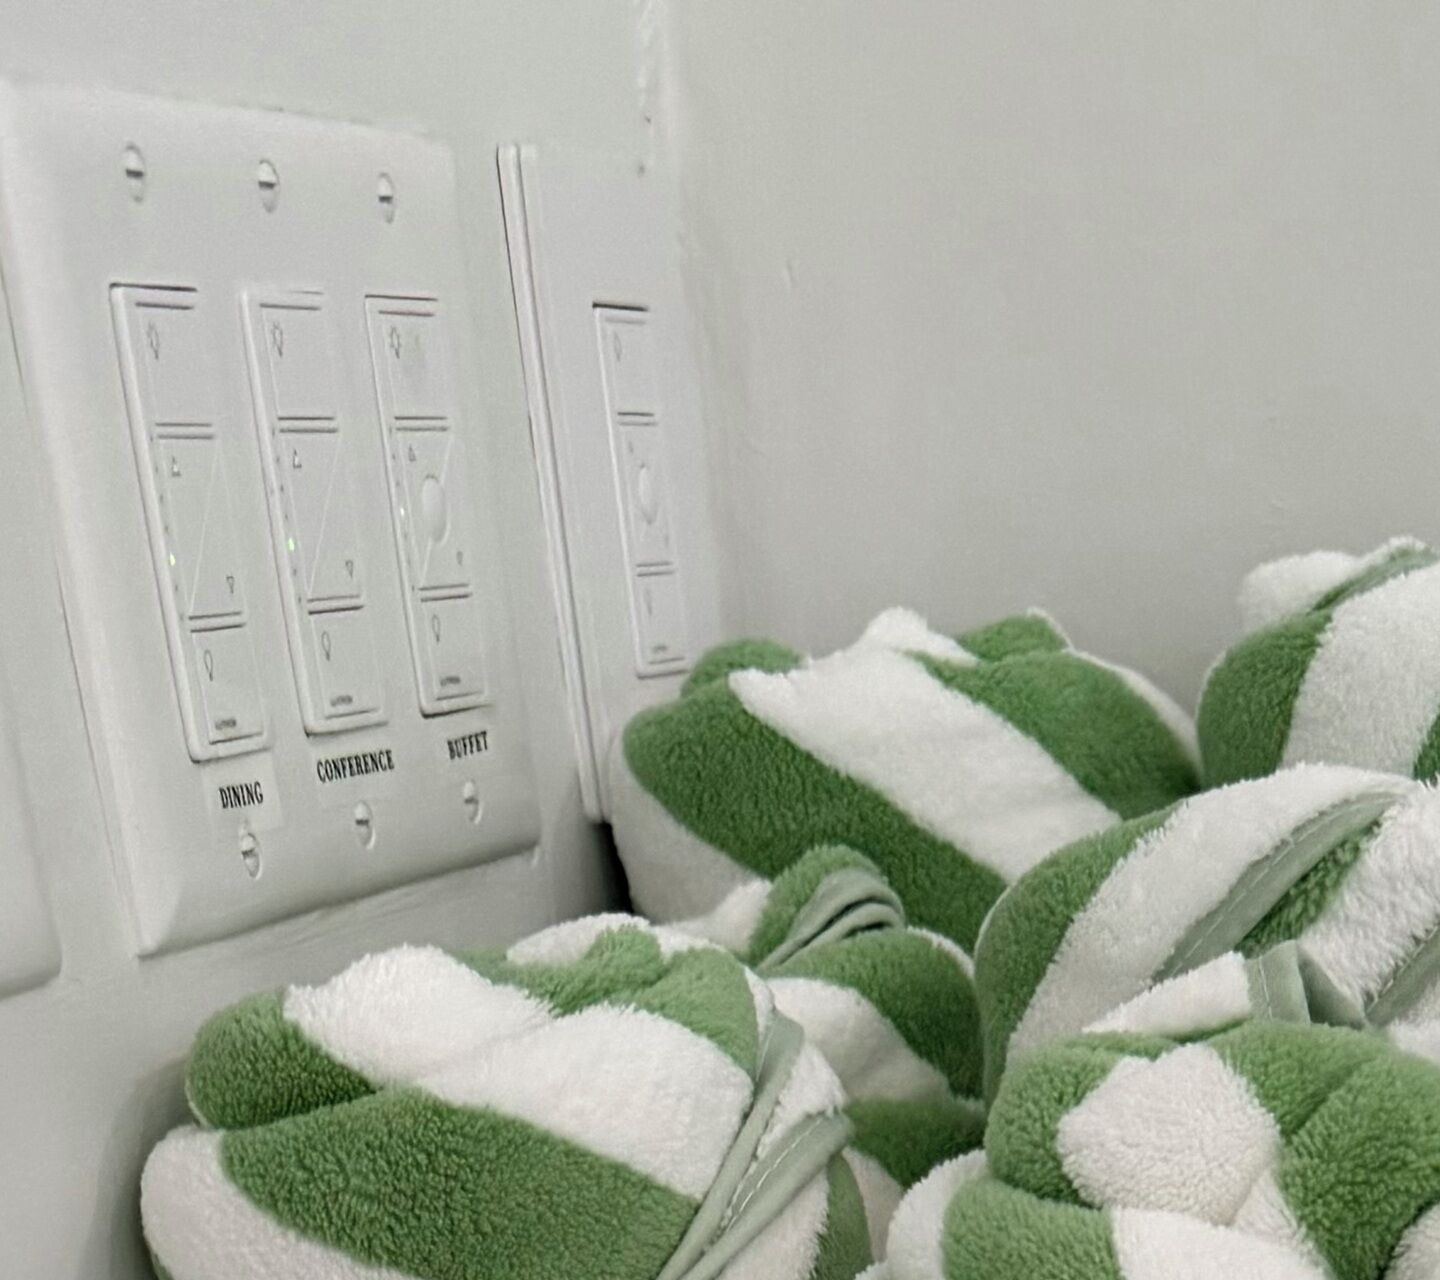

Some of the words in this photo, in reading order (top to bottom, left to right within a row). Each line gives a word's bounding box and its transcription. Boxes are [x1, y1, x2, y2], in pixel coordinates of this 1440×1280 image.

[447, 731, 489, 761] BUFFET
[316, 749, 395, 783] CONFERENCE
[218, 781, 264, 810] DINING
